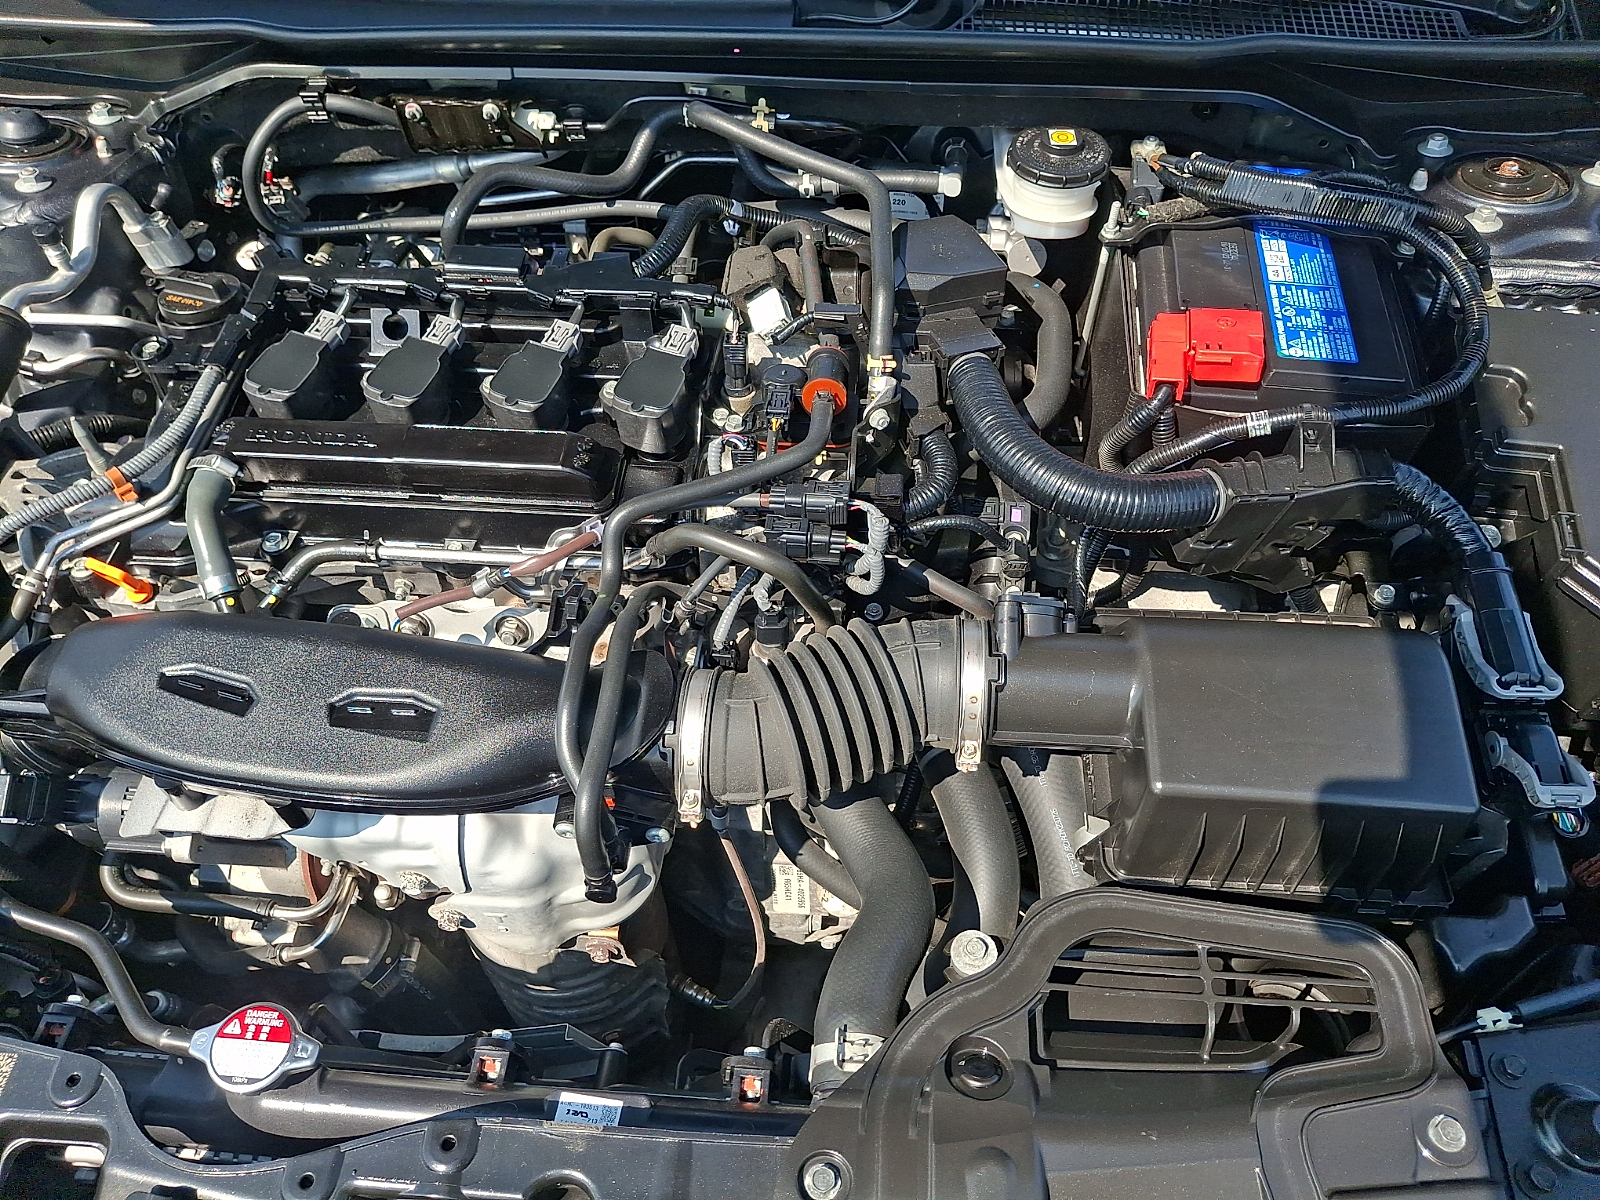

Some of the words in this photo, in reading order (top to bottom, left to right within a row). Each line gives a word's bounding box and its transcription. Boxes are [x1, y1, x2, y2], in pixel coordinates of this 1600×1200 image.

[892, 198, 906, 206] 220
[245, 429, 378, 449] HONDA
[246, 1009, 279, 1020] DANGER
[244, 1016, 284, 1028] WARNUNG
